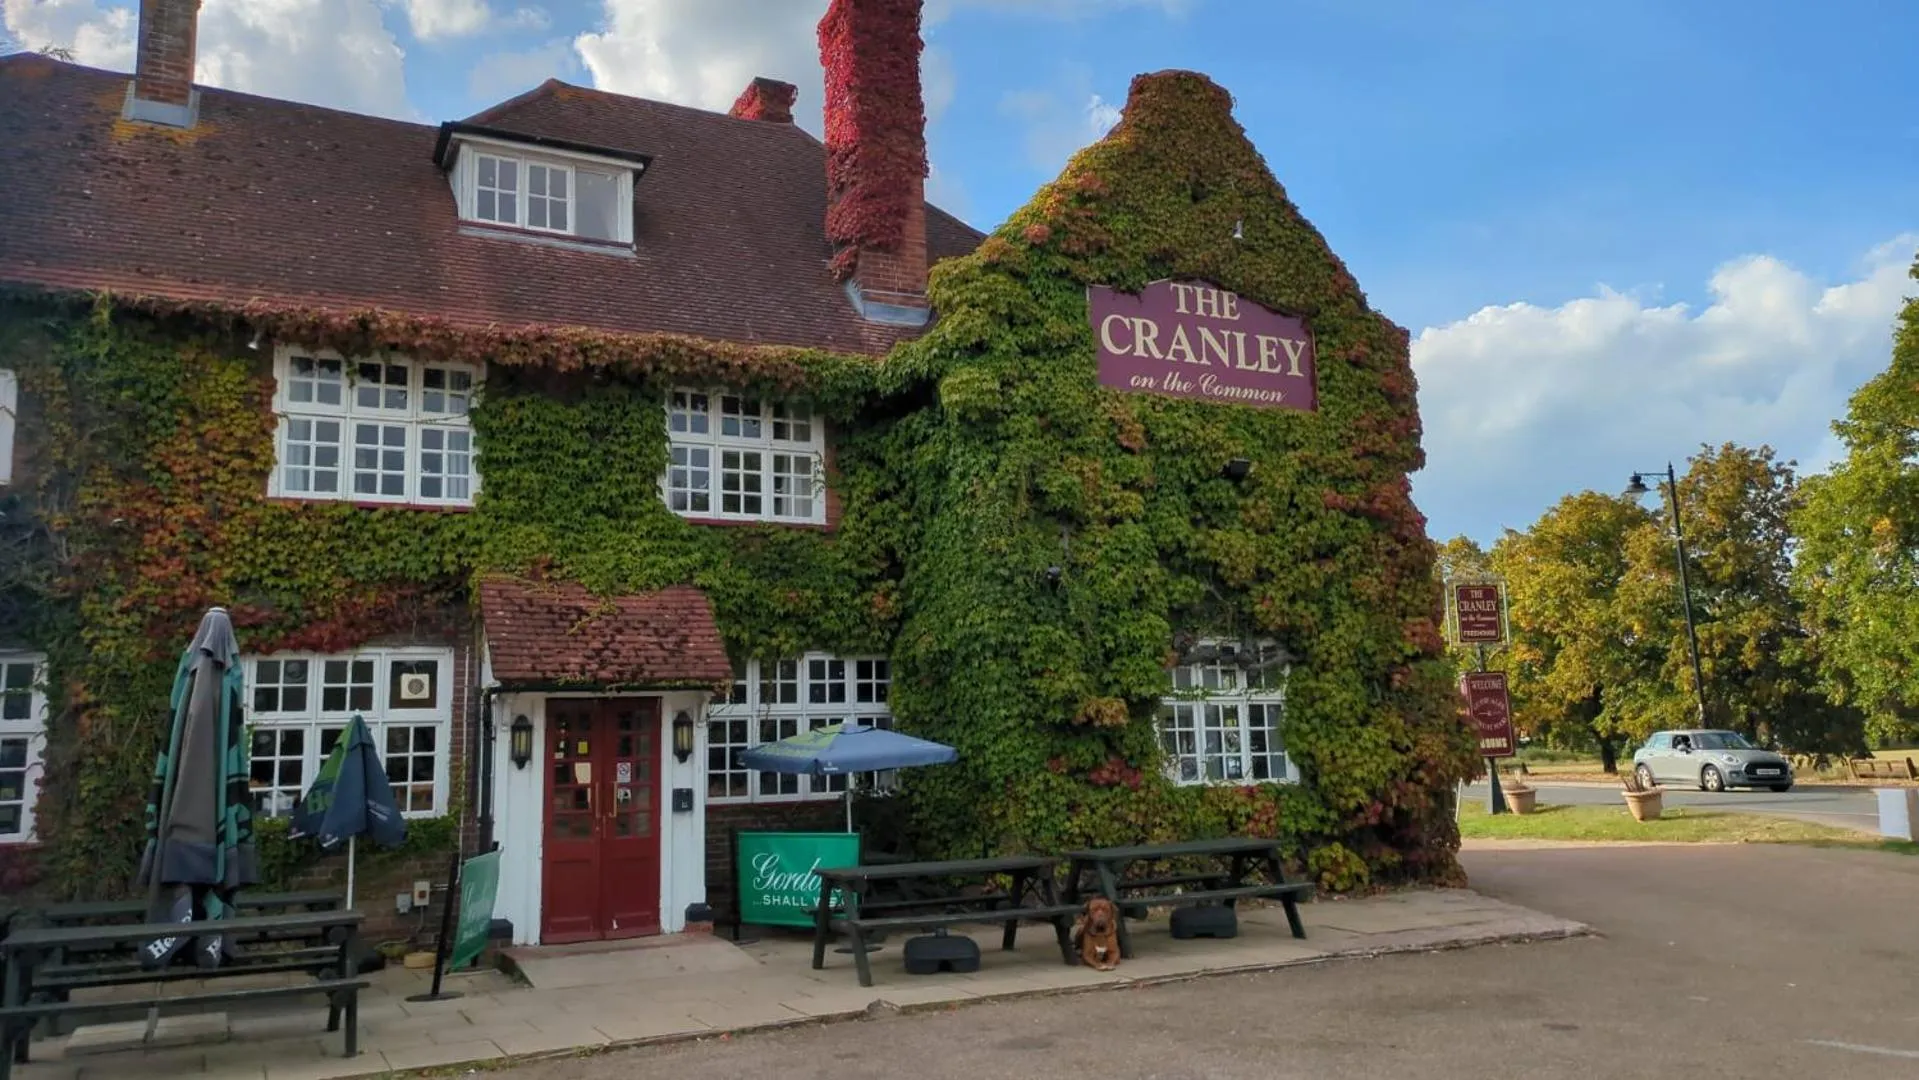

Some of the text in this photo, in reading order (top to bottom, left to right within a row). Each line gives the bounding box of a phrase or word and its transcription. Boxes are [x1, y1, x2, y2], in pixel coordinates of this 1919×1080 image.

[1170, 283, 1240, 320] THE
[1101, 314, 1306, 377] CRANLEY
[1130, 371, 1286, 402] on the Common
[1459, 600, 1497, 612] CRANLEY
[1470, 590, 1483, 599] THE
[752, 853, 822, 891] Gordo
